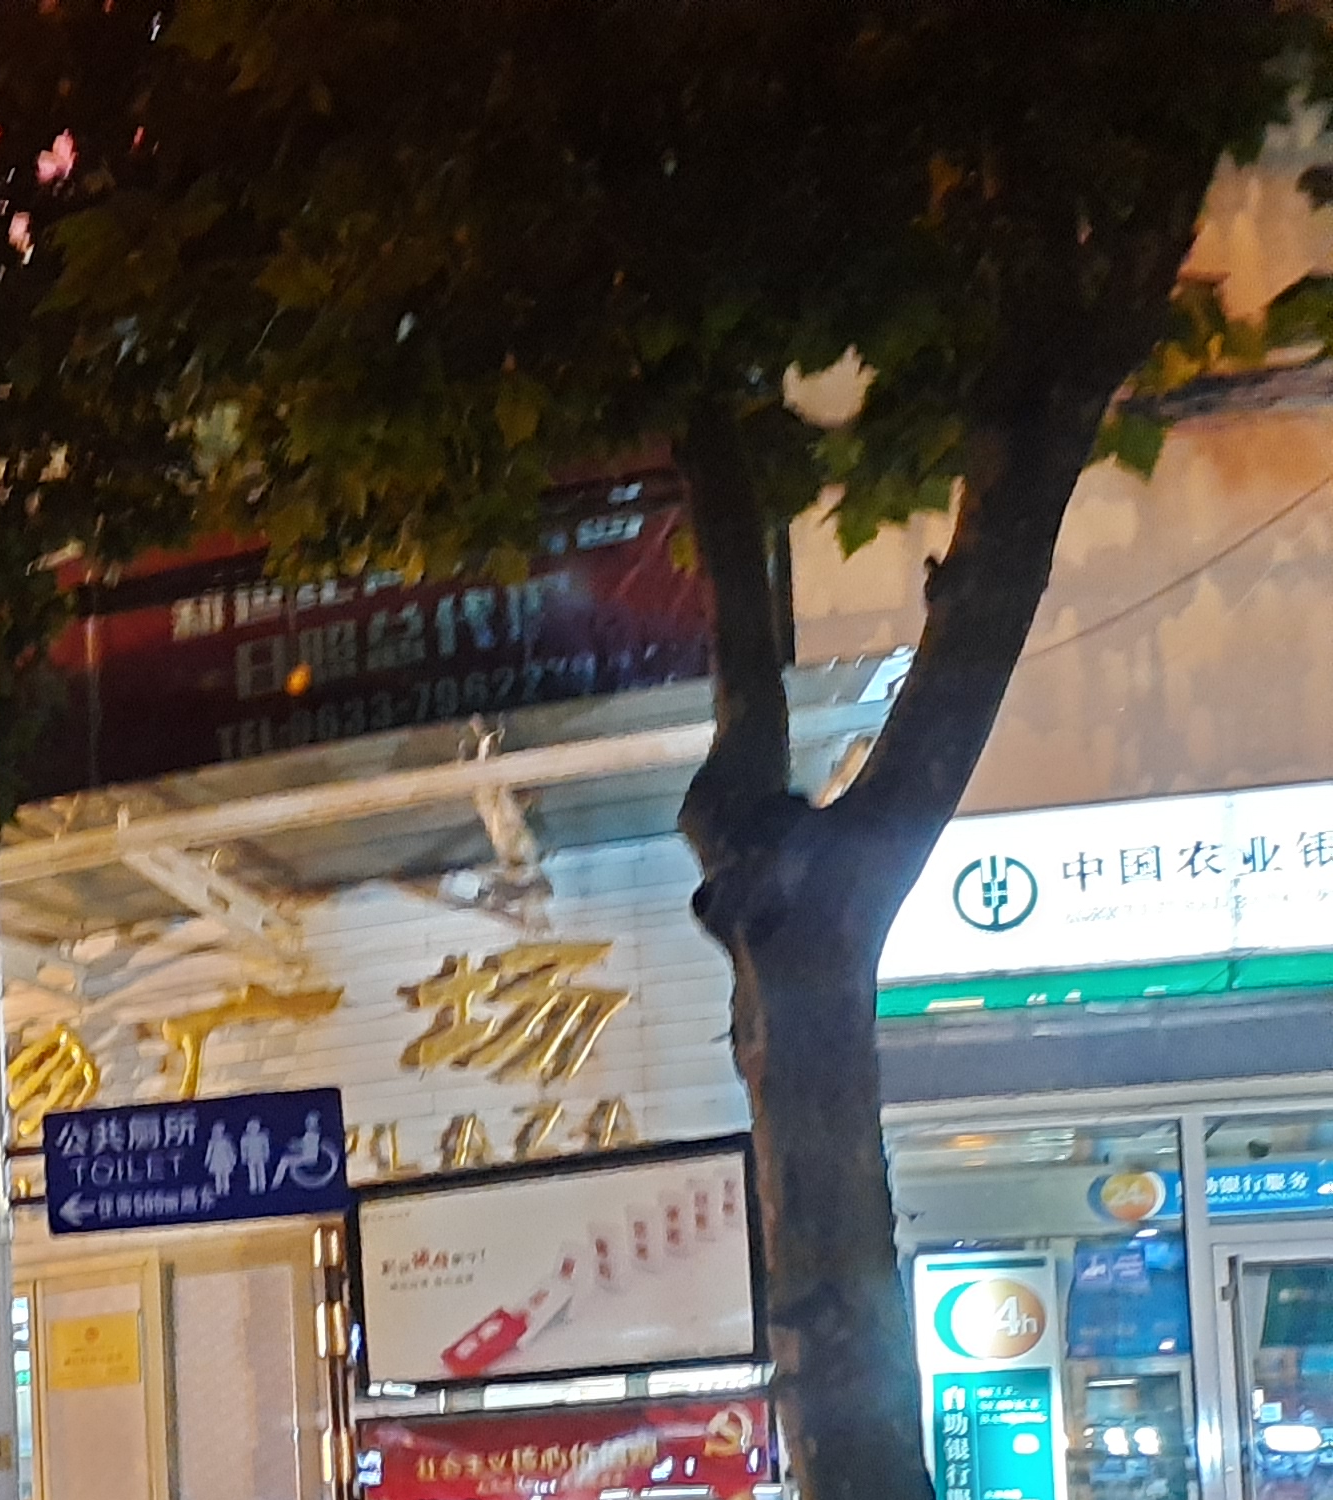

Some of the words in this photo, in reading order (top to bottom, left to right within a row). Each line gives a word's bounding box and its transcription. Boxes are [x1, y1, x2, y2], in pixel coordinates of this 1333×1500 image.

[55, 1108, 198, 1157] 公共厕所
[68, 1150, 183, 1187] TOILET
[1176, 1171, 1309, 1197] 助银行服务
